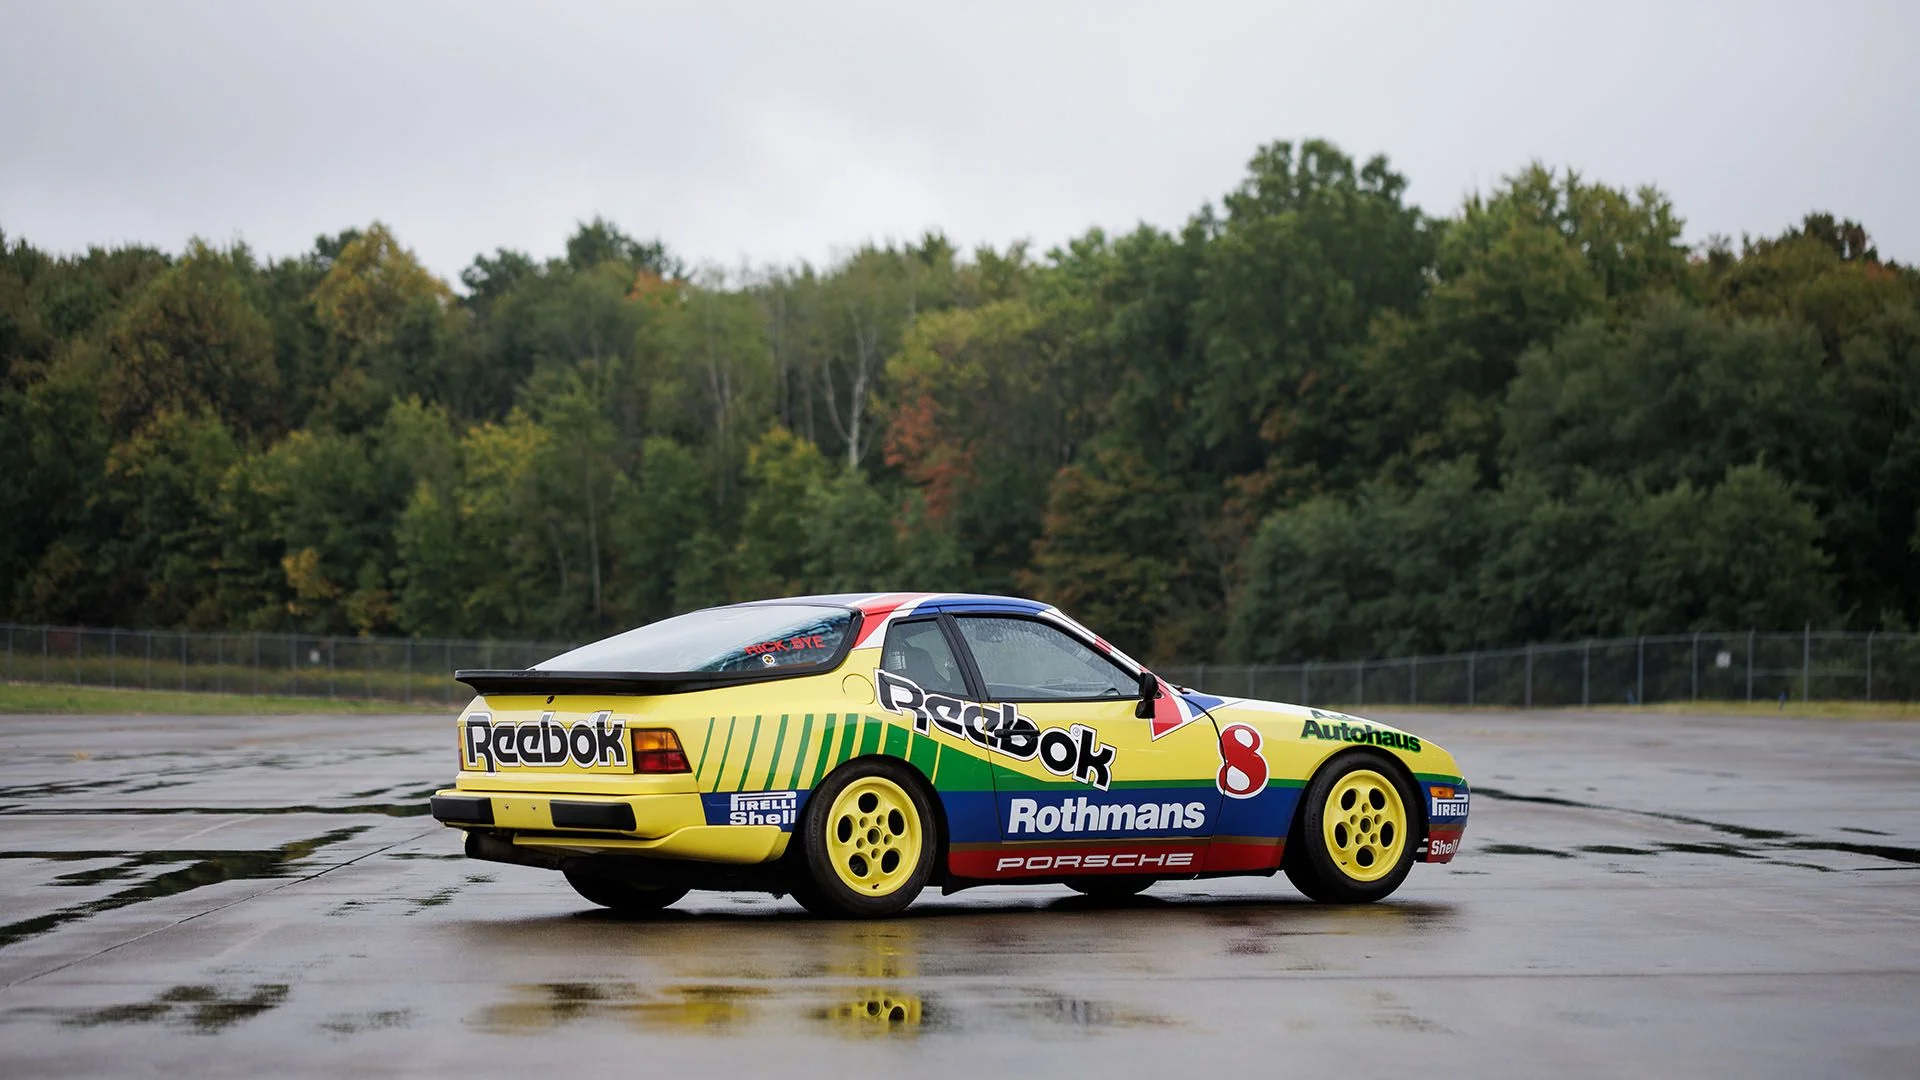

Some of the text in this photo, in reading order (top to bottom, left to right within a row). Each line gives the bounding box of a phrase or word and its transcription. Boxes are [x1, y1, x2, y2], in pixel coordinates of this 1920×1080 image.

[743, 635, 826, 655] RICK BYE
[874, 668, 1117, 791] Reebok
[1300, 719, 1422, 752] Autohaus
[465, 710, 627, 776] Reebok
[1216, 721, 1269, 799] 8
[730, 791, 797, 811] PIRELLI
[1432, 793, 1469, 816] PIRELLI
[729, 810, 796, 825] Shell
[1007, 797, 1206, 833] Rothmans
[1430, 838, 1459, 855] Shell
[996, 853, 1194, 871] PORSCHE
